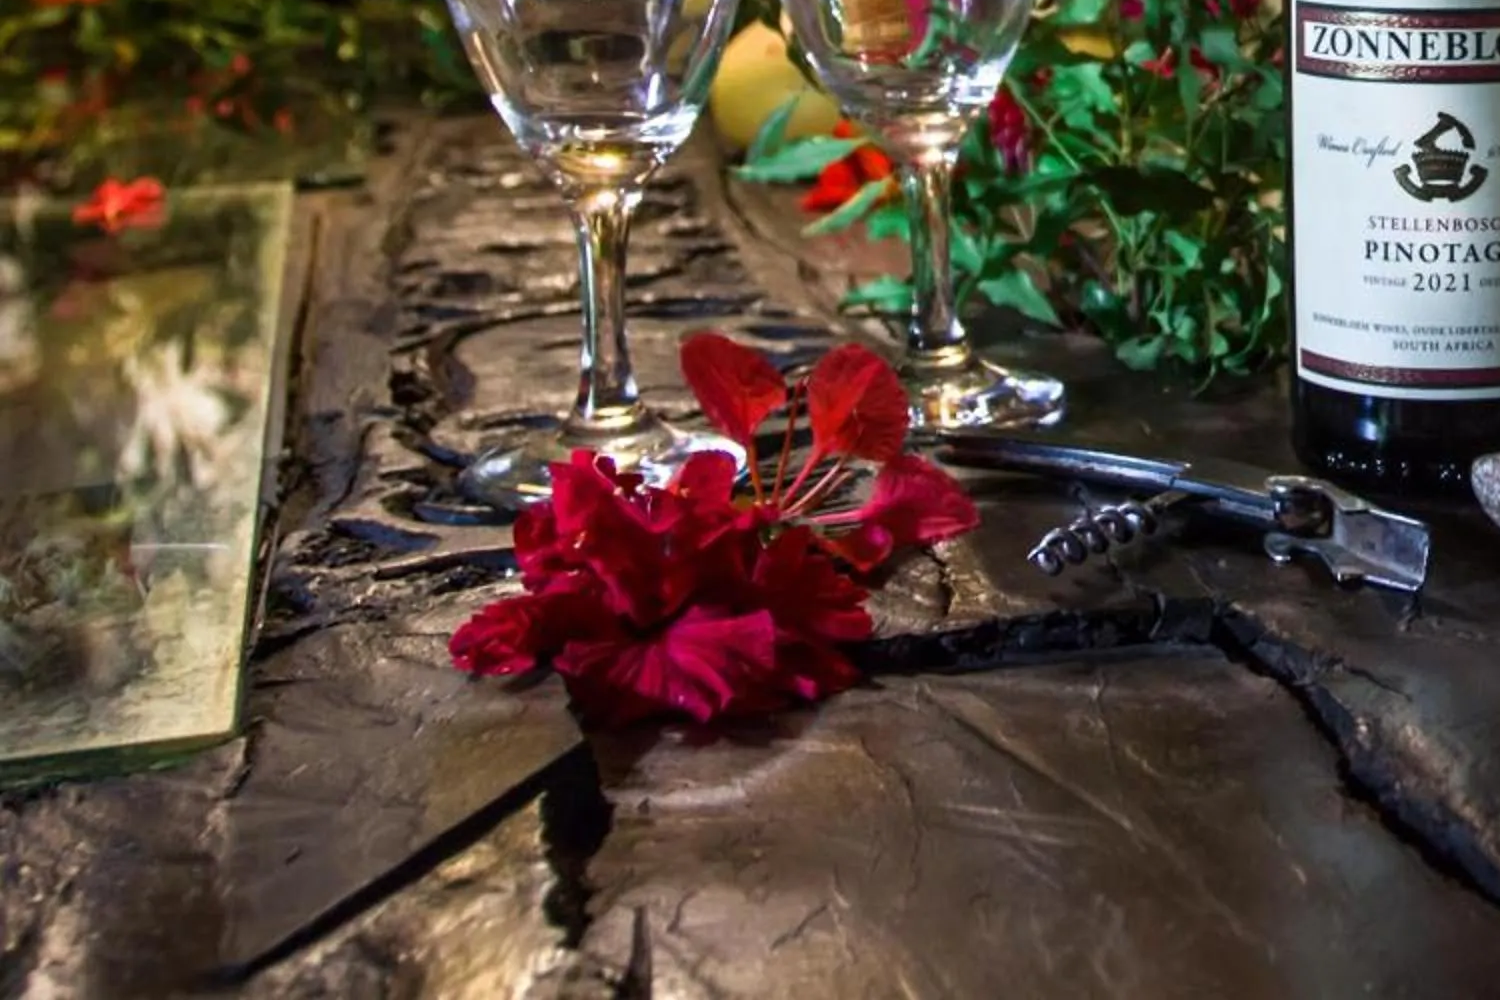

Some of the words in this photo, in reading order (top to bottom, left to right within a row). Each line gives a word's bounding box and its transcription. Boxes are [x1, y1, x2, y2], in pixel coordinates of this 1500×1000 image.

[1413, 272, 1471, 292] 2021
[1393, 338, 1439, 351] SOUTH
[1445, 339, 1495, 351] AFRICA
